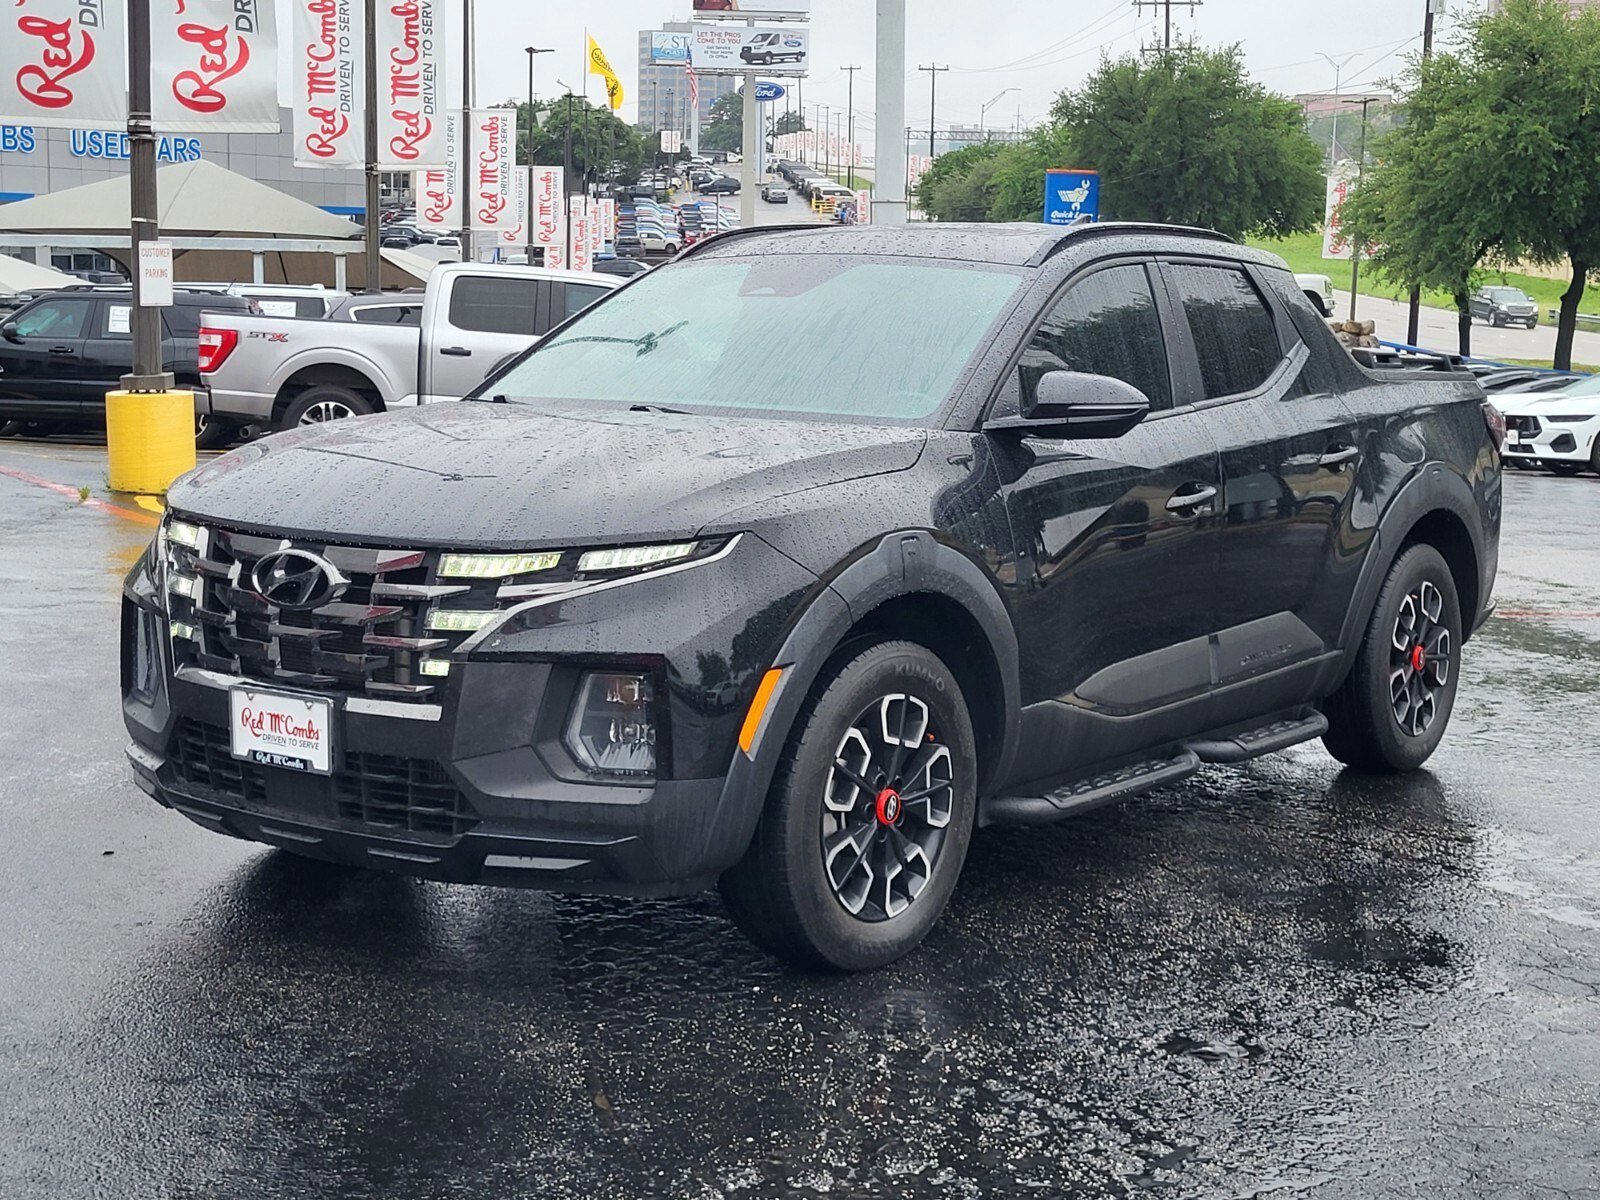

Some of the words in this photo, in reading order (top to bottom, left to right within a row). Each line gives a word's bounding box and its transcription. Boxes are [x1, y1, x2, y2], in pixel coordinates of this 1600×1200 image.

[339, 37, 350, 55] TO
[390, 0, 420, 105] McComb
[423, 39, 433, 59] TO
[671, 36, 690, 49] ST
[16, 16, 95, 108] Red
[172, 23, 250, 113] Red
[340, 60, 351, 113] DRIVEN
[423, 63, 434, 115] DRIVEN
[306, 107, 349, 157] Red
[390, 110, 432, 160] Red
[447, 116, 455, 143] SERVE
[500, 117, 508, 143] SERVE
[72, 129, 131, 160] USED
[157, 136, 201, 162] ARS
[447, 145, 455, 159] TO
[480, 116, 499, 188] McCombs
[500, 146, 508, 159] TO
[447, 161, 455, 195] DRIVEN
[500, 162, 508, 195] DRIVEN
[424, 191, 452, 222] Red
[478, 192, 506, 224] Red
[518, 190, 524, 200] TO
[539, 171, 552, 218] McCombs
[553, 191, 559, 200] TO
[1051, 210, 1074, 219] Quick
[538, 221, 556, 242] Red
[141, 247, 170, 257] CUSTOMER
[145, 268, 168, 278] PARKING
[246, 331, 288, 342] STX
[895, 664, 945, 692] KUMHO
[241, 707, 264, 737] Red
[266, 712, 319, 740] McCombs
[262, 734, 286, 744] DRIVEN
[299, 740, 320, 750] SERVE
[256, 752, 271, 764] Red
[271, 755, 304, 770] McCombs
